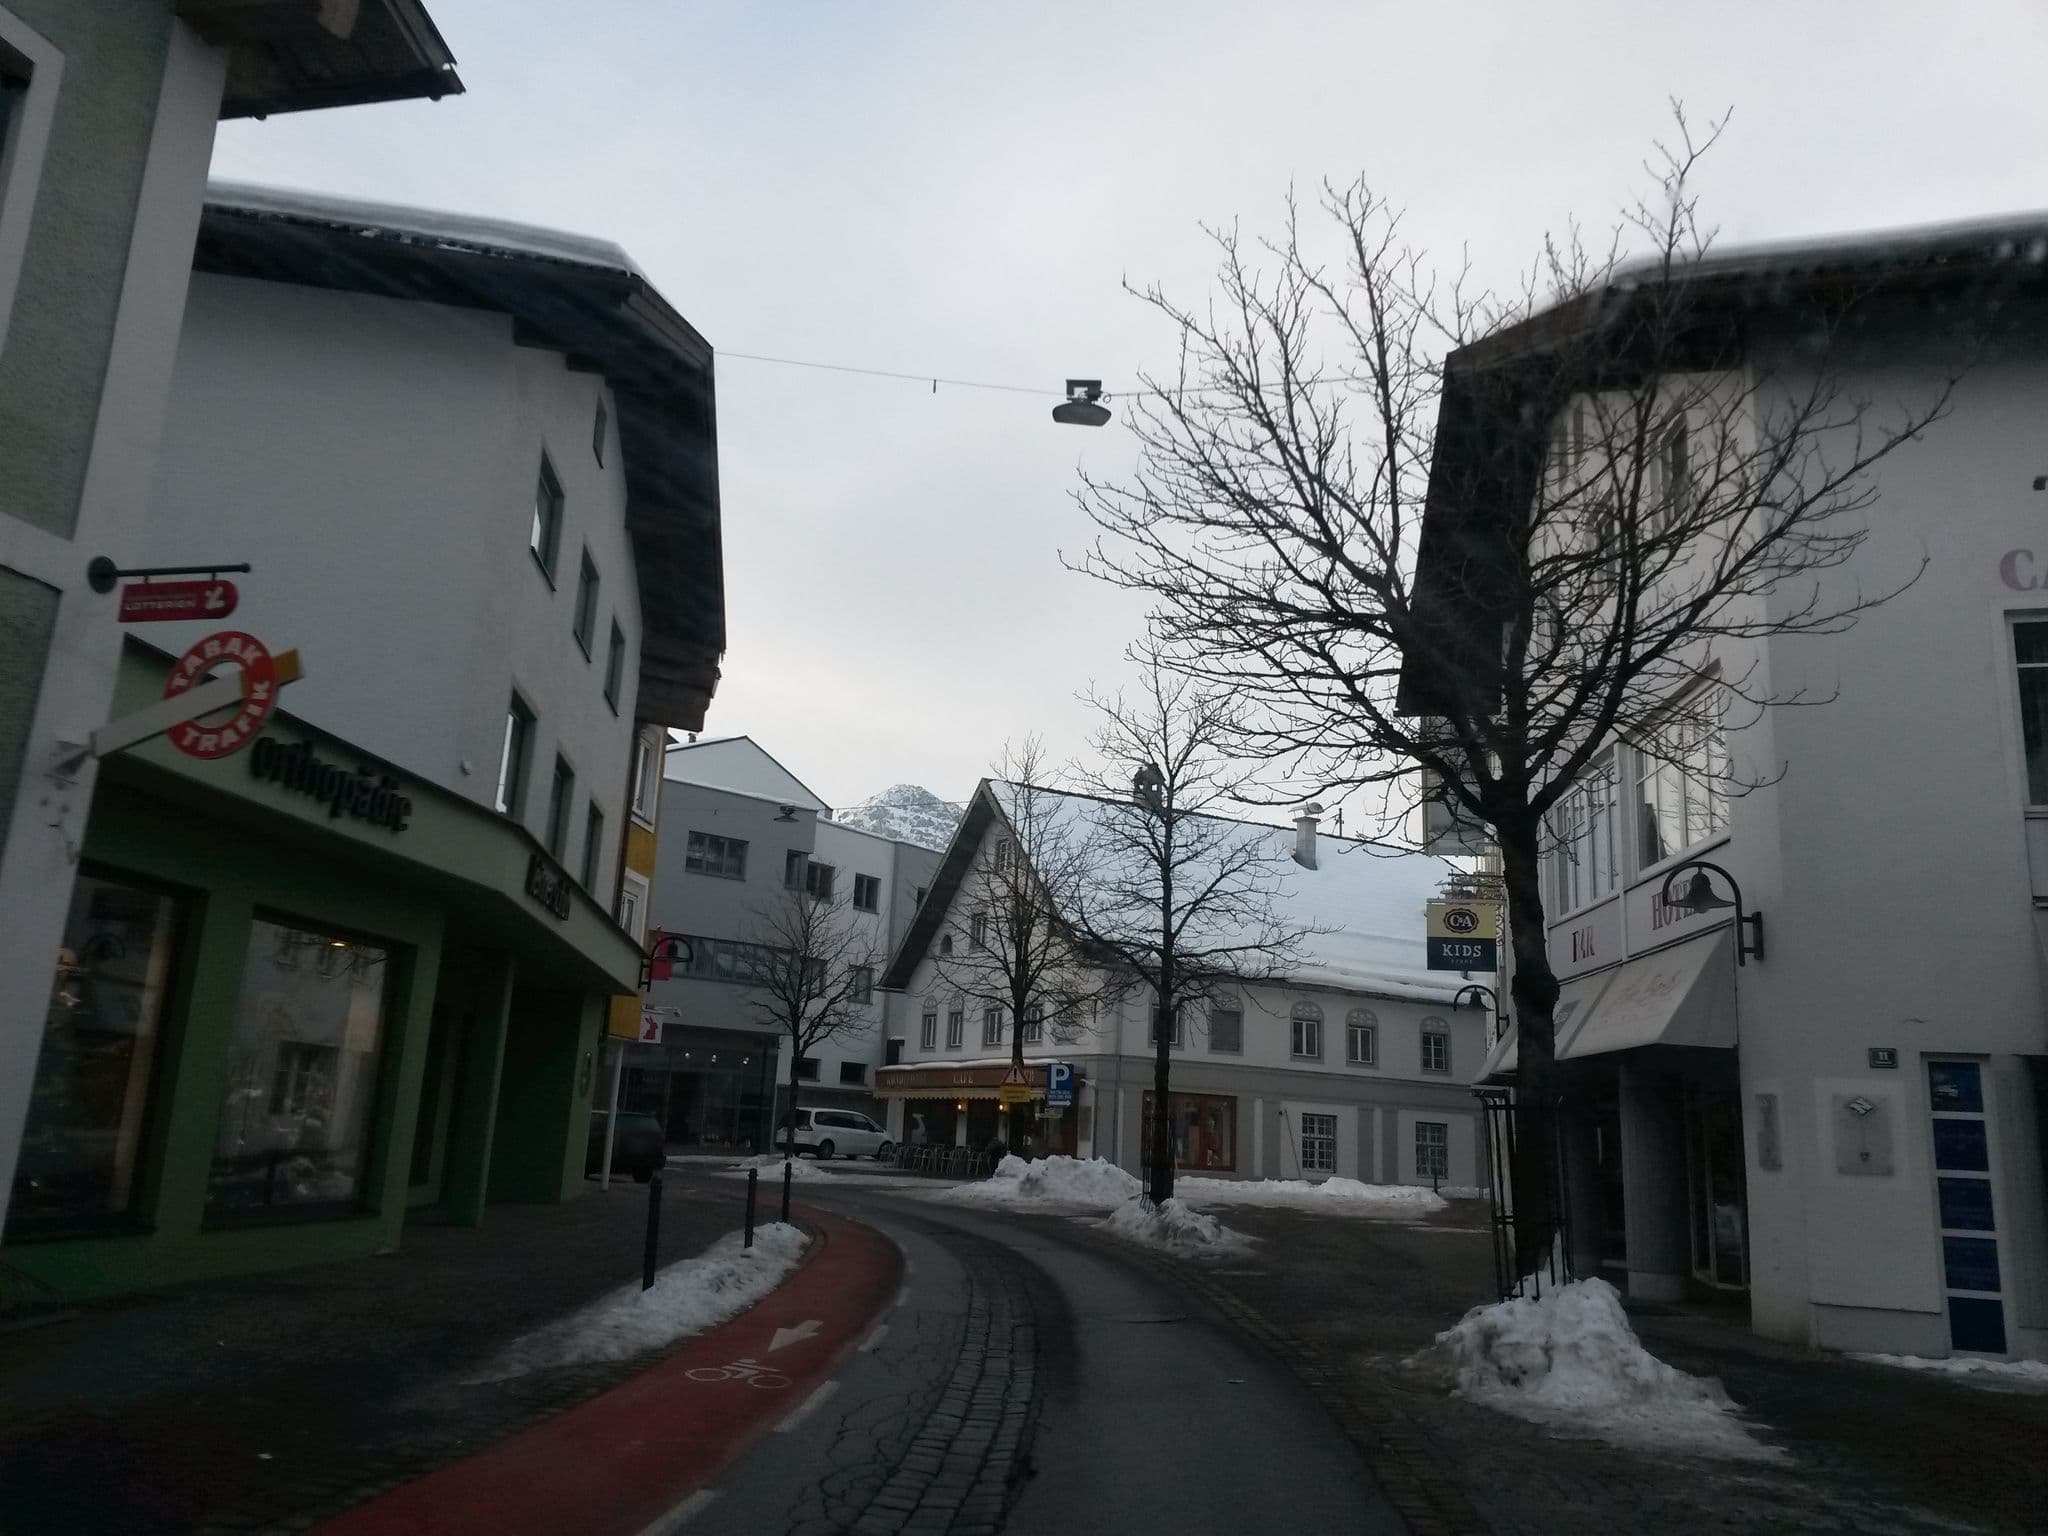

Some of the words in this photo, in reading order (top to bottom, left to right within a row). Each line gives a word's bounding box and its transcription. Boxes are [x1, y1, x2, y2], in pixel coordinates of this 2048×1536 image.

[171, 637, 264, 690] TABAK
[181, 680, 271, 752] TRAFIK
[1449, 914, 1473, 927] C&A
[1442, 944, 1482, 958] KIDS
[1050, 1064, 1070, 1090] P
